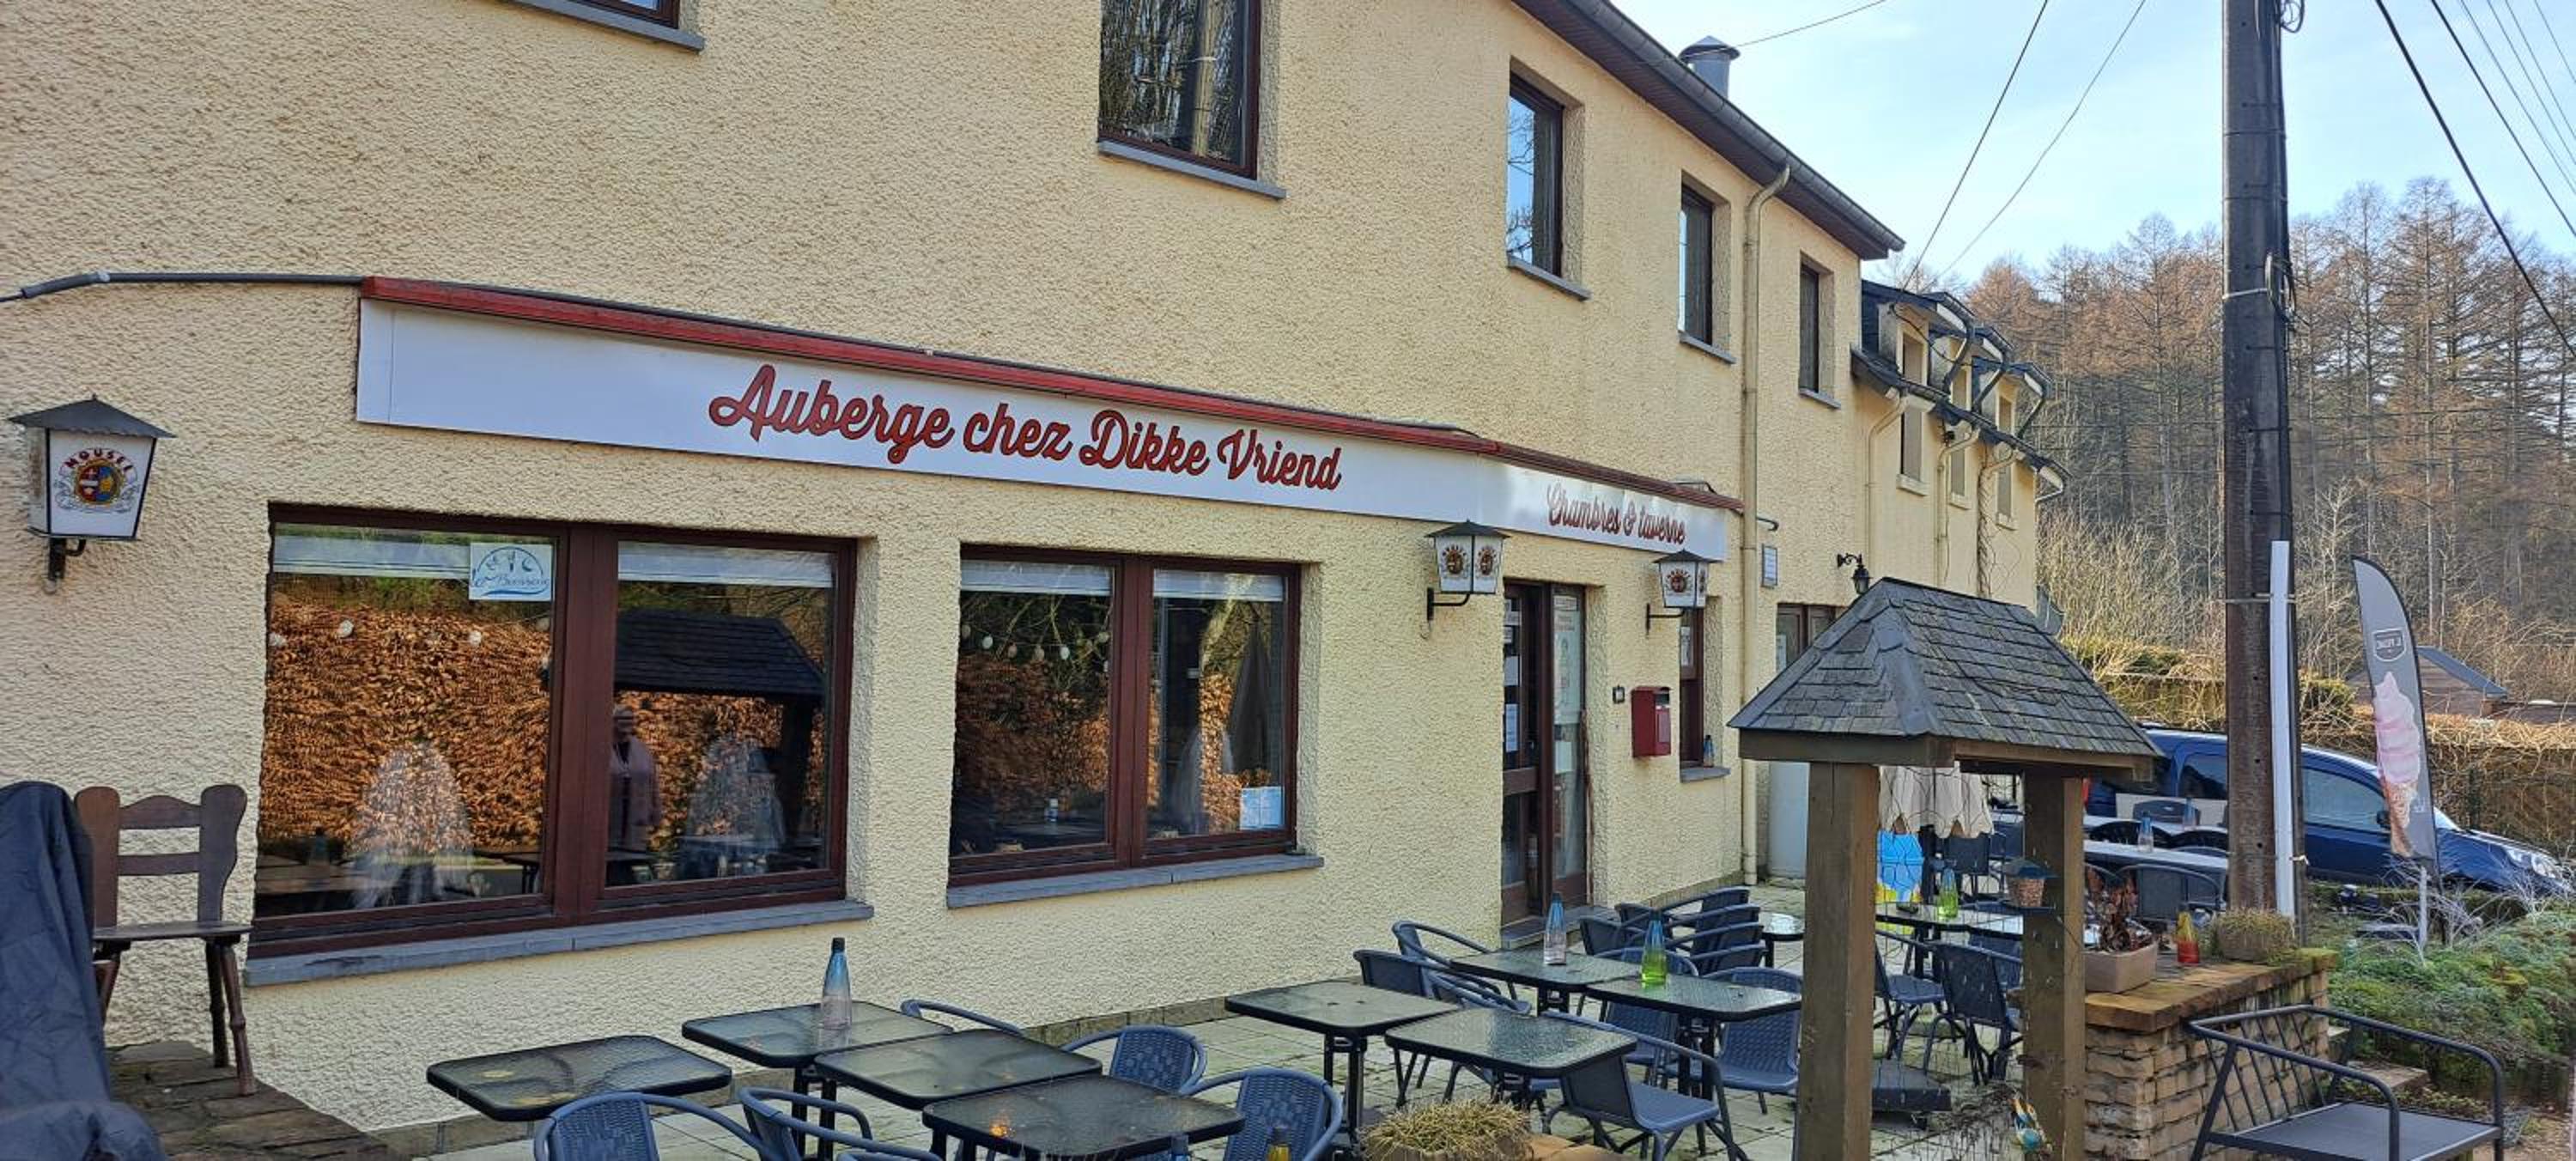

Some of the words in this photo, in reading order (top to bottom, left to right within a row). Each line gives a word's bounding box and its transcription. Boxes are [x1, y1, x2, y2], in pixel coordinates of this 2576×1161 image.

[708, 364, 954, 464] Auberge
[963, 403, 1073, 461] chez
[1079, 410, 1209, 477] Dikke
[1217, 429, 1342, 490] Vriend
[1547, 483, 1621, 535] Chambres
[1623, 501, 1637, 537] &
[1638, 506, 1686, 544] taverne
